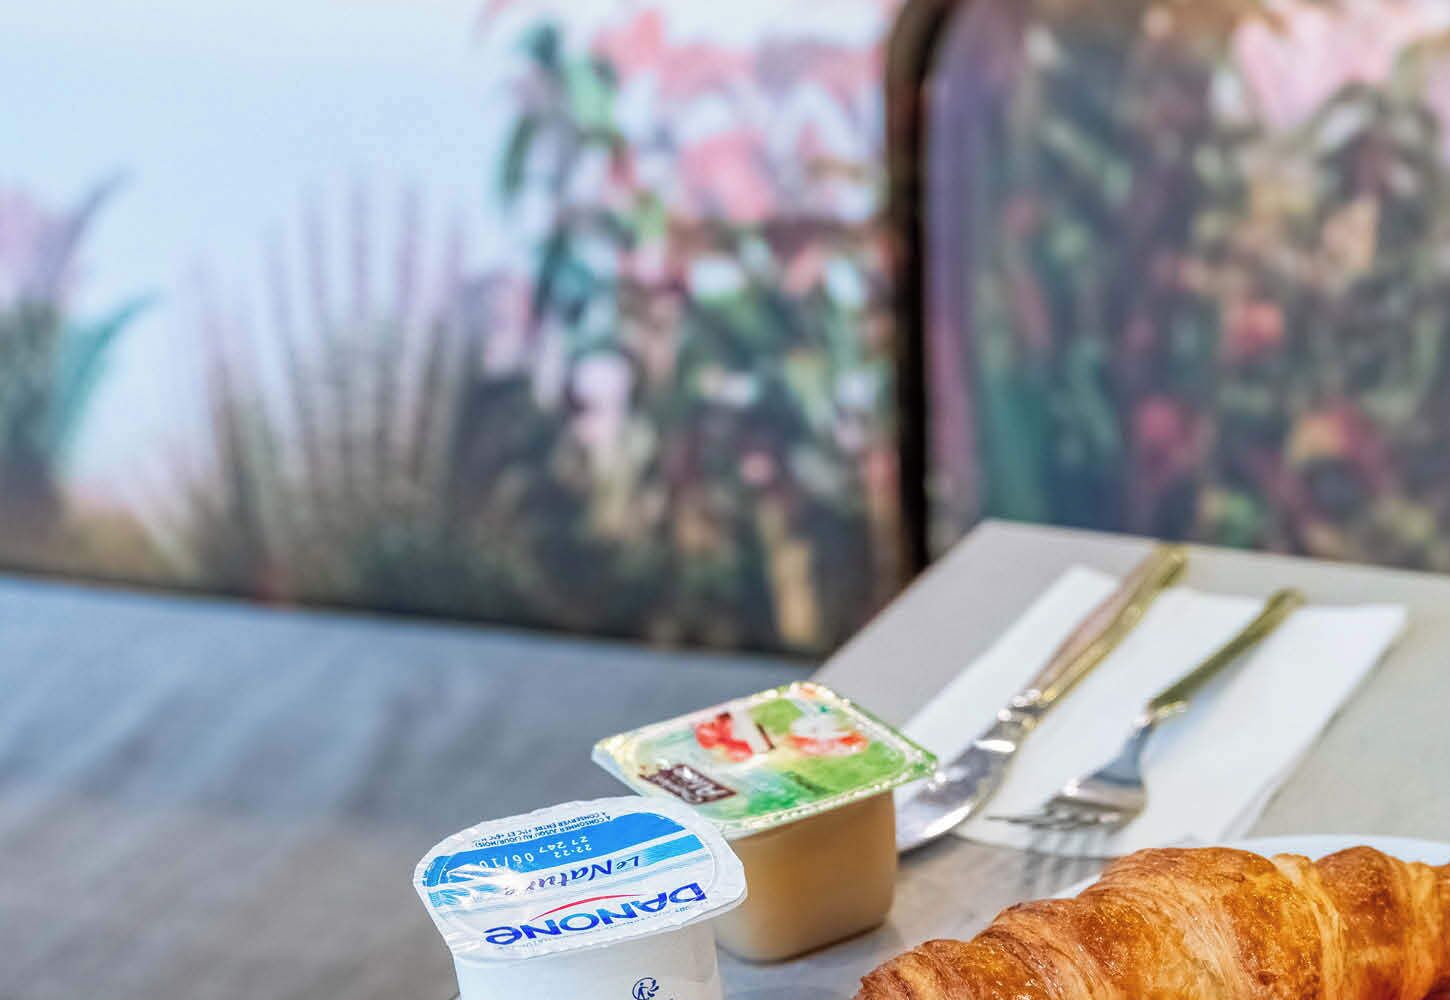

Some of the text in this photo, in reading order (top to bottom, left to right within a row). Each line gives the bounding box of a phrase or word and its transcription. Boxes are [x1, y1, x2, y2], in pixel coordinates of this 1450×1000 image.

[559, 813, 600, 826] CONSERVER
[559, 817, 605, 832] CONSOMMER
[535, 823, 557, 832] ENTRE
[616, 856, 640, 872] Le
